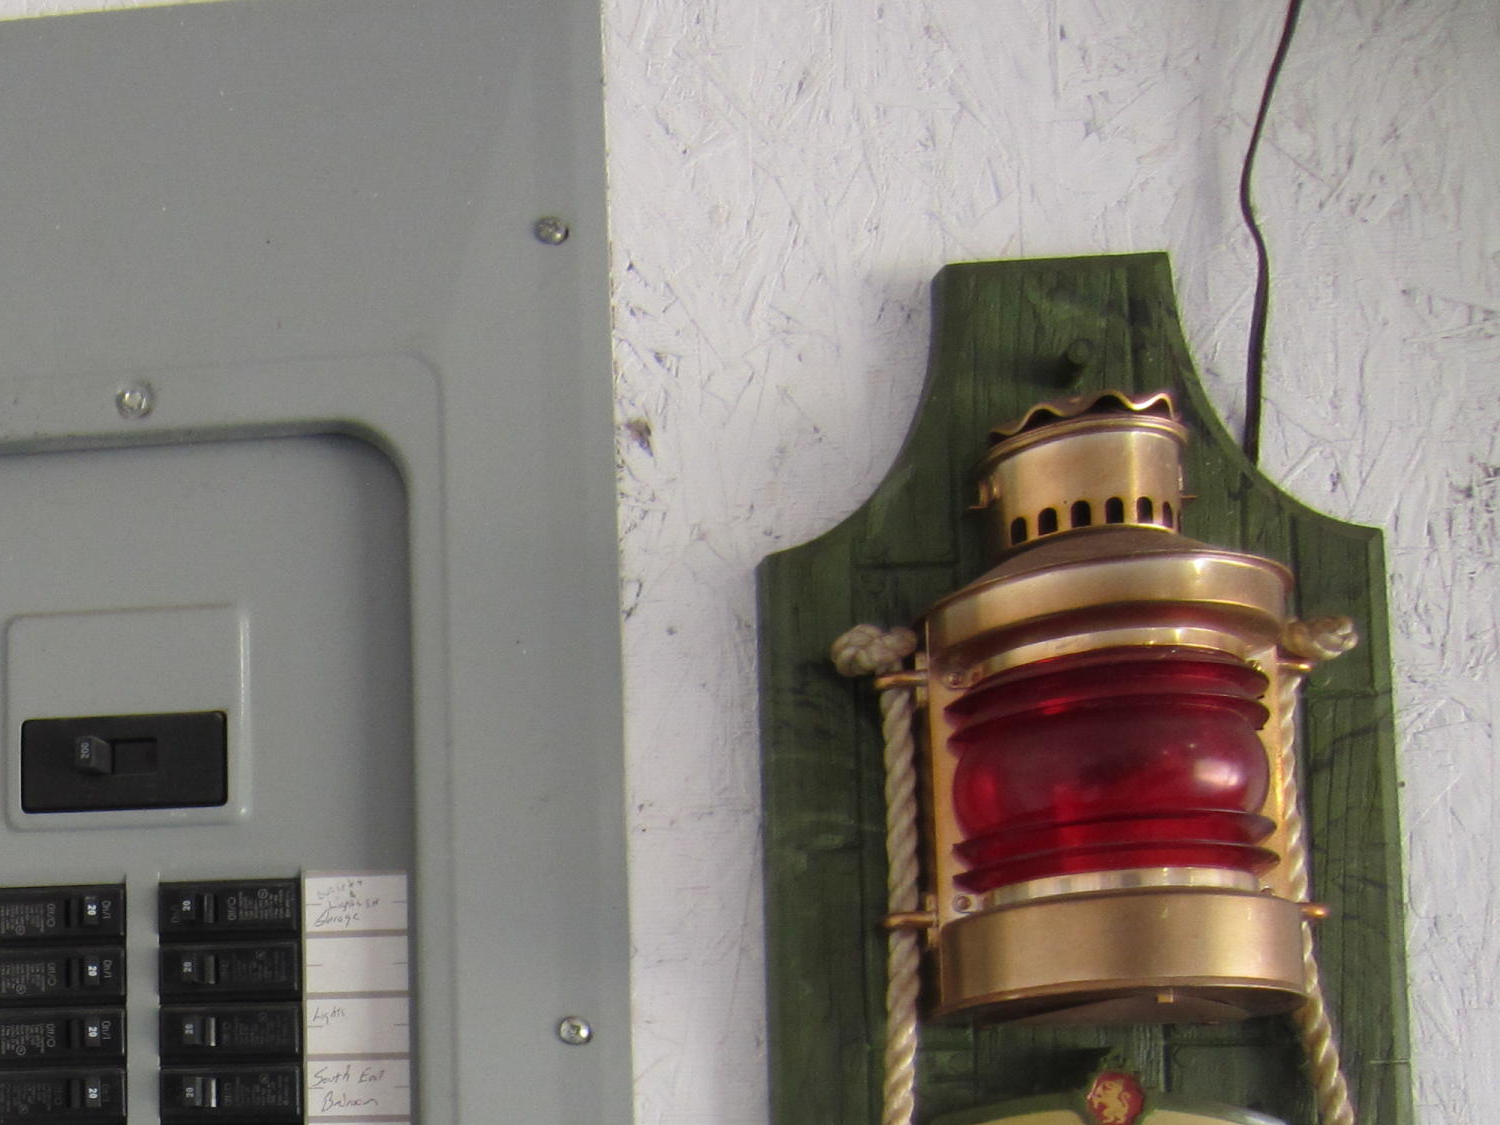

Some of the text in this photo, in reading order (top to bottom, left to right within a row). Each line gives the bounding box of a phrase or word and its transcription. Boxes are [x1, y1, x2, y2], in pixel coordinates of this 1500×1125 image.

[87, 904, 97, 915] 20
[88, 966, 98, 976] 20
[88, 1027, 98, 1037] 20
[88, 1088, 98, 1099] 20
